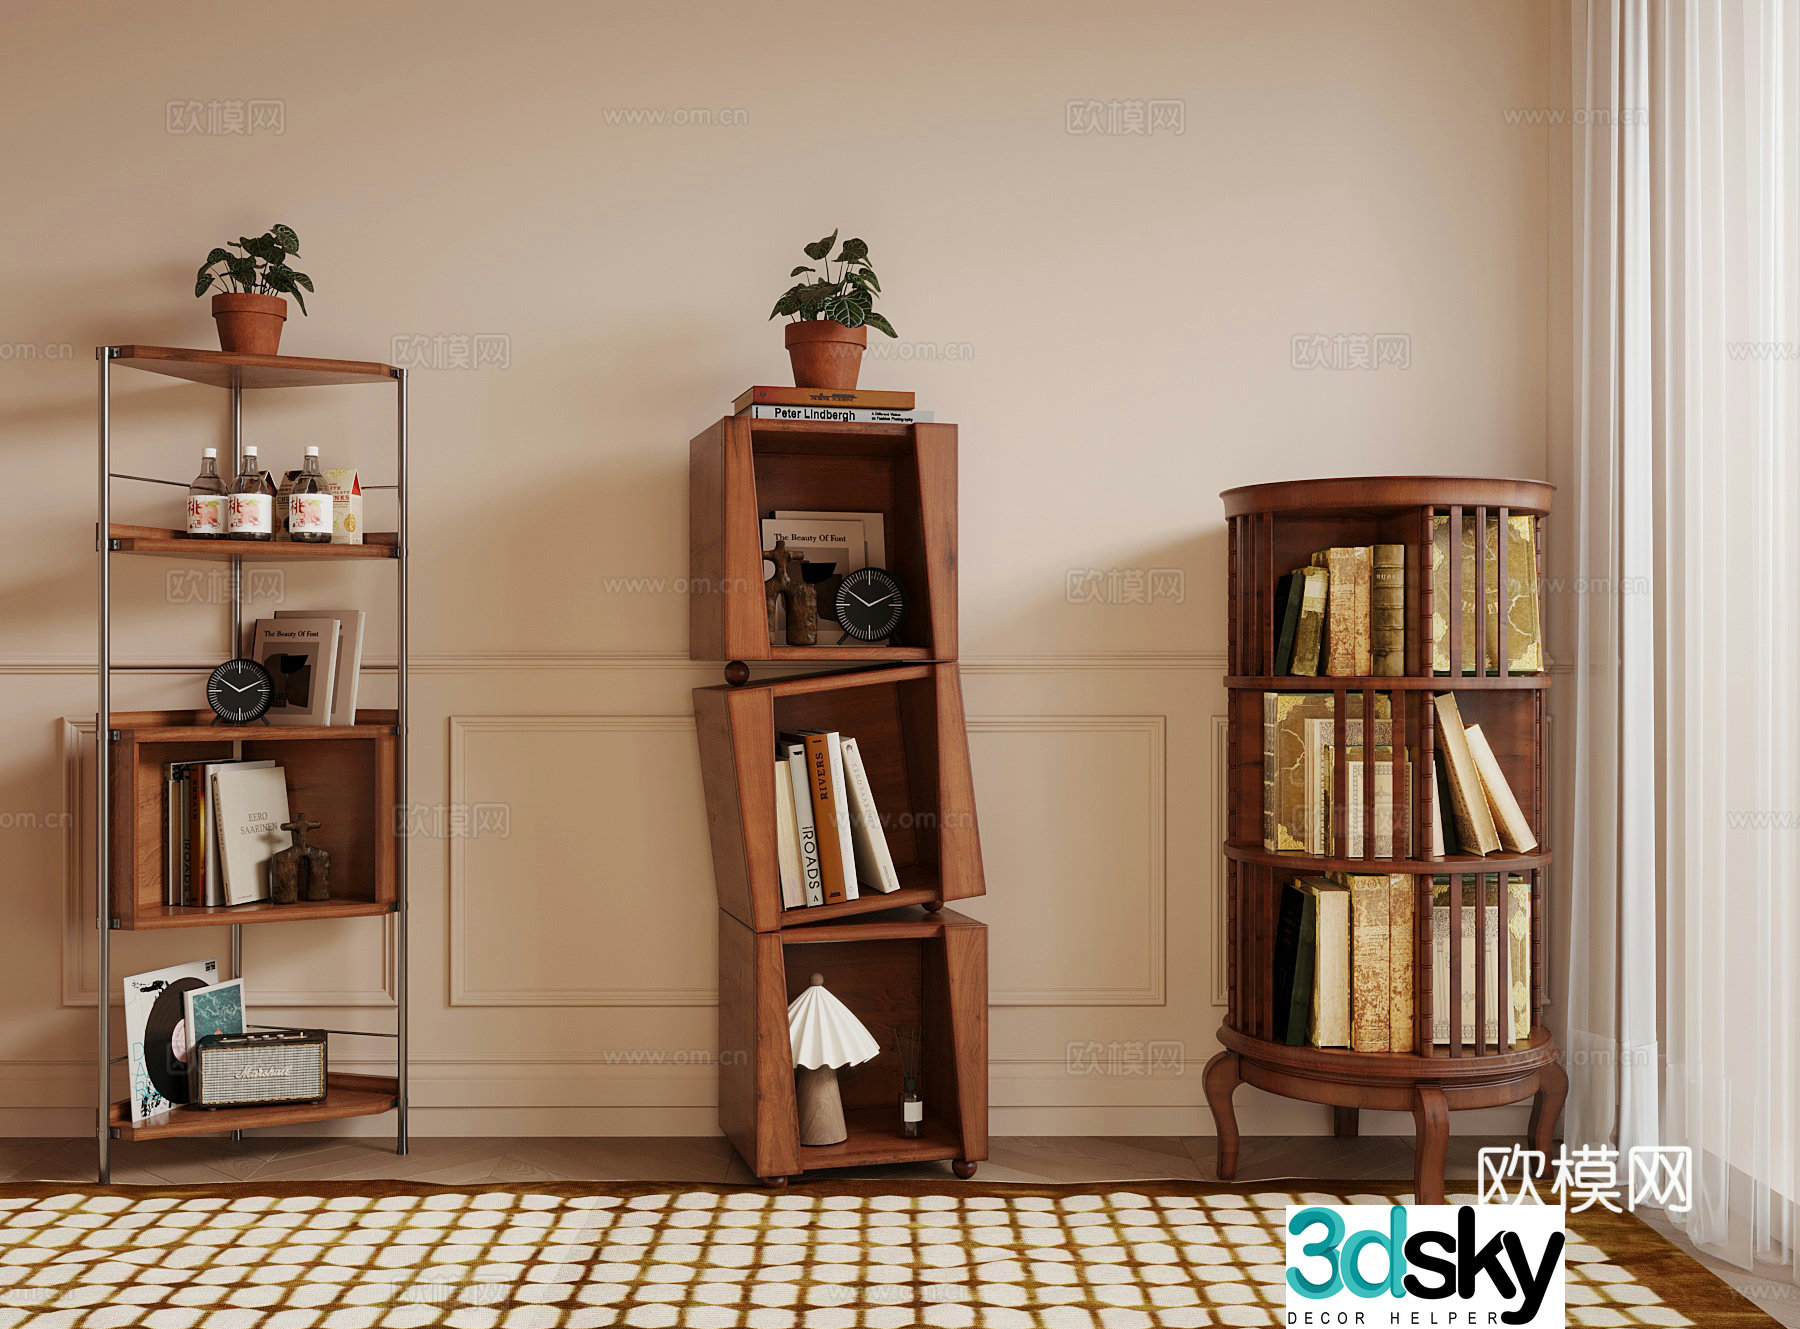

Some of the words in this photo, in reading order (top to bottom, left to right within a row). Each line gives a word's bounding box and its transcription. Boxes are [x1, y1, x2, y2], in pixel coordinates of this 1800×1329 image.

[774, 407, 802, 418] Peter
[804, 408, 856, 422] Lindbergh
[229, 495, 243, 516] 桃
[291, 495, 305, 516] 桃
[773, 533, 789, 541] The
[791, 533, 817, 543] Beauty
[819, 534, 829, 542] Of
[830, 534, 847, 542] Font
[276, 630, 296, 639] Beauty
[297, 630, 306, 638] Of
[815, 751, 829, 801] RIVERS
[248, 811, 268, 822] EERO
[240, 822, 278, 836] SAARINEN
[234, 1065, 293, 1079] Marshall
